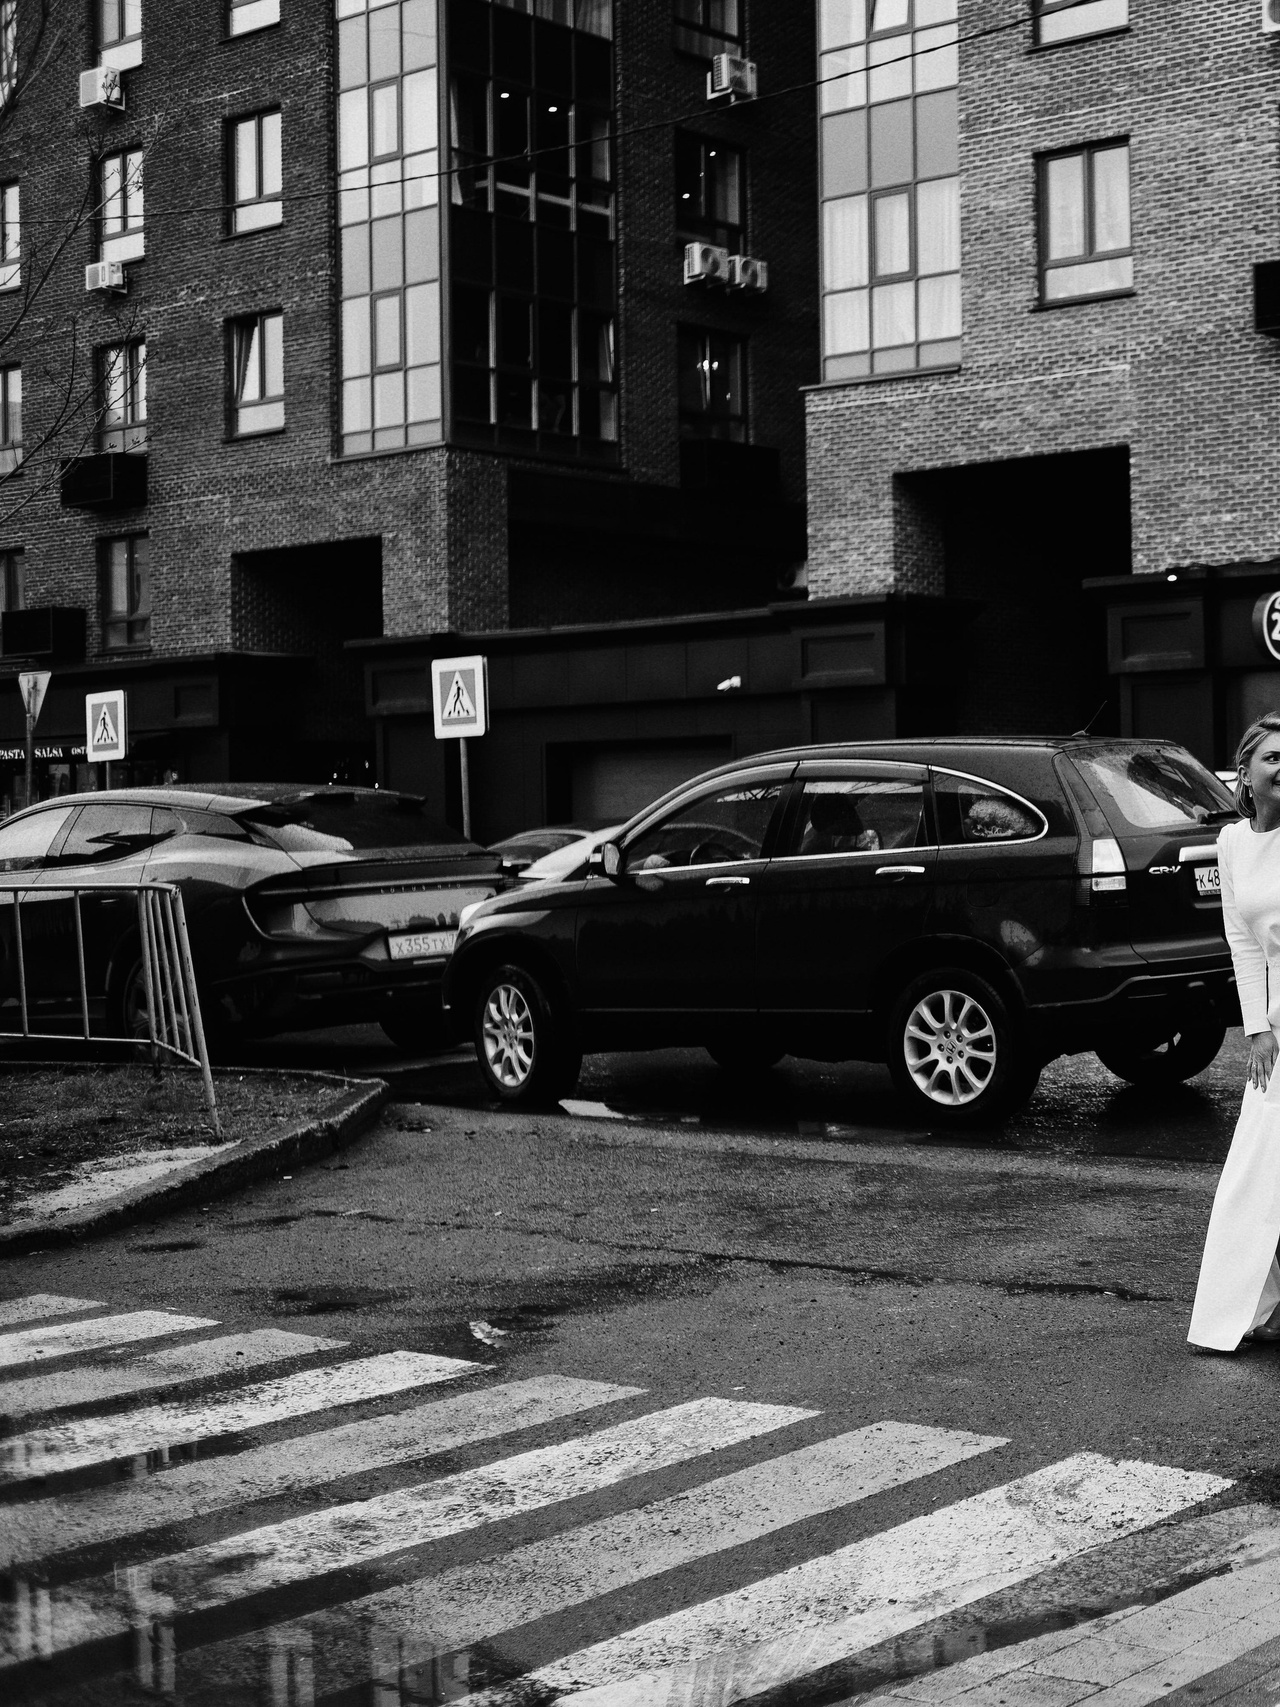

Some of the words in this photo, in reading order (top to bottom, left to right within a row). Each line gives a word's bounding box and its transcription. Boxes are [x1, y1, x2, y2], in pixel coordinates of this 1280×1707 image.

[0, 749, 25, 760] PASTA
[34, 747, 63, 758] SALSA
[71, 746, 87, 755] OST
[1148, 865, 1182, 874] CR-V
[1198, 868, 1221, 889] К48
